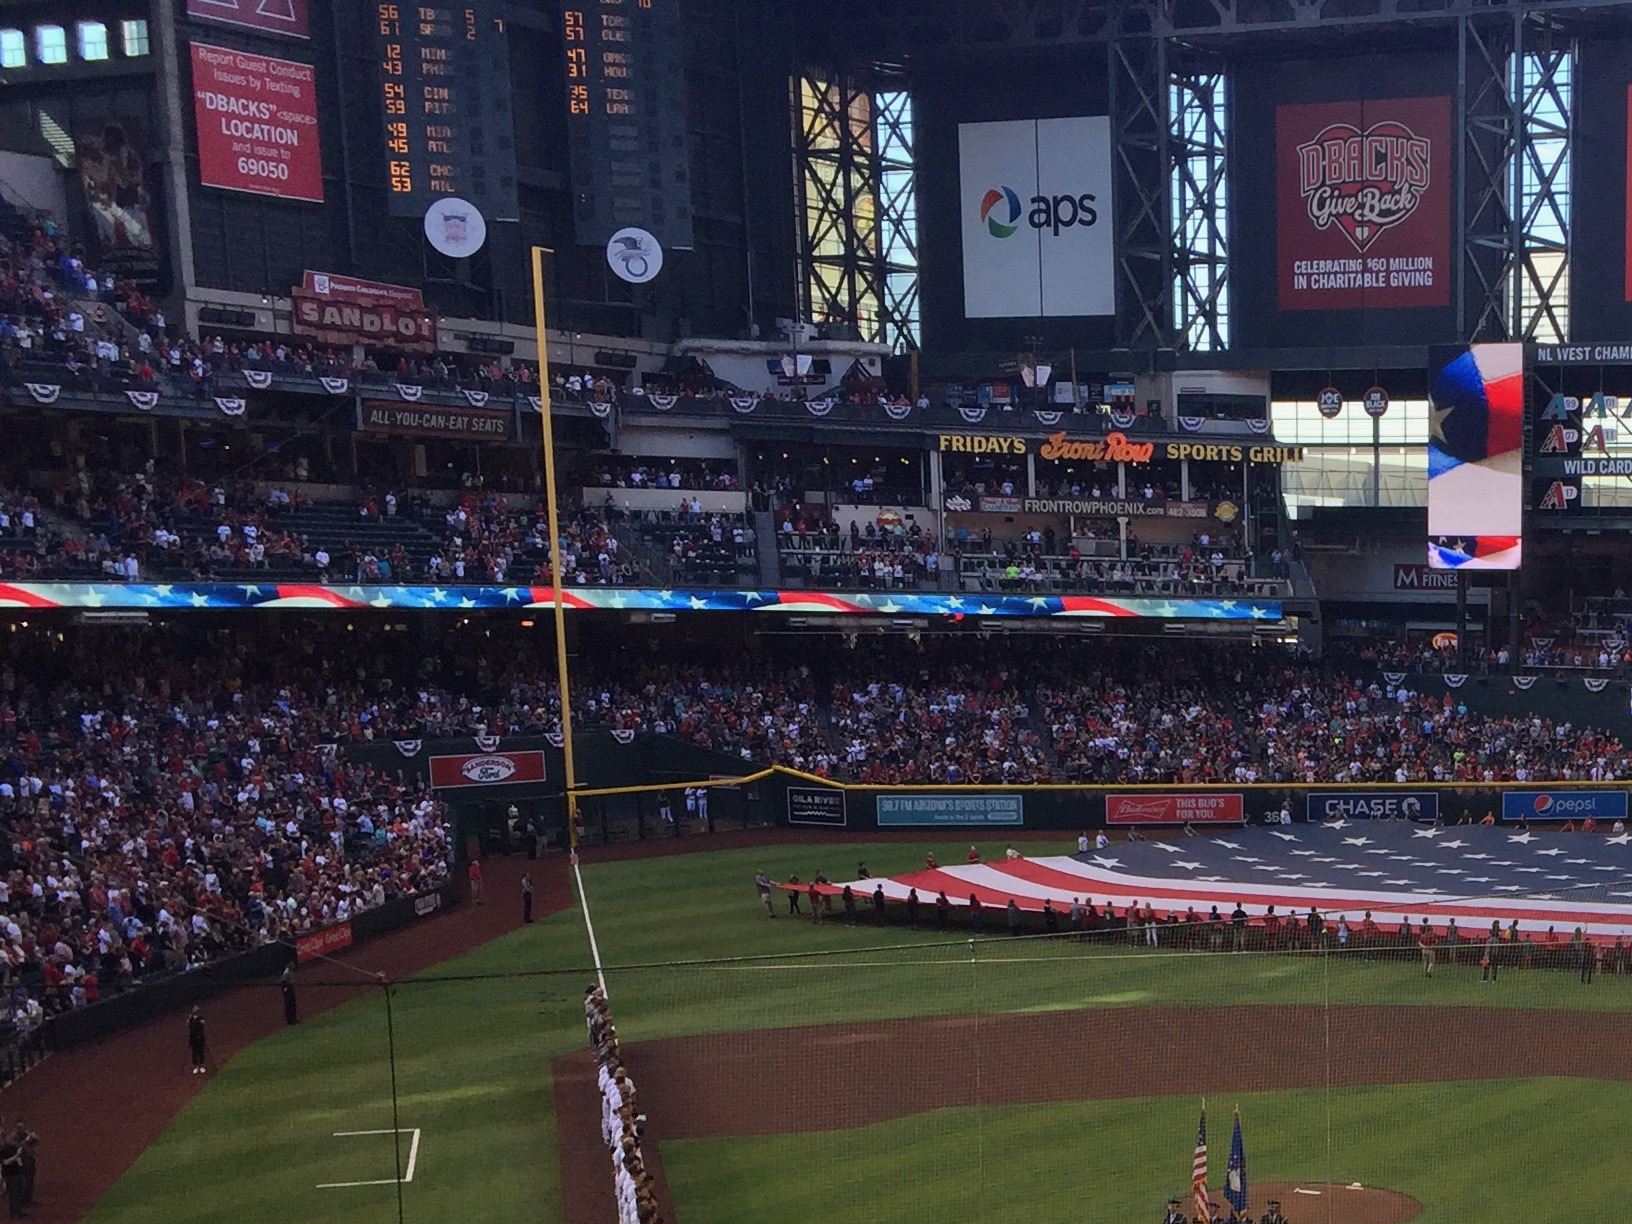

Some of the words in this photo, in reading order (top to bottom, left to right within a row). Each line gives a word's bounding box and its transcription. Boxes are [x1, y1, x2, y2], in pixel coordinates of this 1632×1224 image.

[379, 4, 399, 19] 56
[419, 7, 435, 20] TB
[565, 11, 583, 26] 57
[565, 27, 584, 40] 57
[566, 49, 586, 62] 47
[199, 48, 235, 66] Report
[236, 56, 267, 74] Guest
[269, 62, 312, 82] Conduct
[383, 61, 402, 75] 43
[569, 63, 587, 77] 31
[213, 68, 247, 86] Issues
[249, 75, 262, 91] by
[264, 77, 301, 98] Texting
[384, 83, 404, 98] 54
[386, 99, 405, 114] 59
[221, 117, 299, 146] LOCATION
[387, 123, 407, 137] 49
[231, 141, 251, 153] and
[254, 144, 279, 158] issue
[280, 146, 291, 160] to
[389, 139, 409, 153] 45
[428, 140, 452, 153] ATL
[237, 156, 289, 180] 69050
[390, 161, 410, 176] 62
[392, 177, 411, 192] 53
[431, 179, 456, 192] MIL
[1311, 185, 1357, 225] Give
[1358, 183, 1416, 222] Back
[1028, 192, 1098, 237] aps
[1293, 258, 1364, 274] CELEBRATING
[1366, 257, 1387, 270] $60
[1389, 256, 1433, 271] MILLION
[1294, 275, 1307, 290] IN
[1310, 272, 1387, 289] CHARITABLE
[1389, 271, 1433, 288] GIVING
[302, 302, 433, 336] SANDLOT
[1538, 348, 1553, 361] NL
[1556, 346, 1593, 361] WEST
[370, 409, 470, 430] ALL-YOU-CAN-EAT
[471, 418, 504, 433] SEATS
[939, 435, 1027, 455] FRIDAY'S
[1040, 431, 1104, 461] Front
[1104, 431, 1154, 463] Row
[1166, 443, 1243, 461] SPORTS
[1249, 445, 1304, 463] GRILL
[1564, 460, 1596, 475] WILD
[1396, 568, 1419, 587] M
[478, 766, 501, 780] Ford
[1175, 798, 1197, 809] THIS
[1325, 799, 1398, 816] CHASE
[1555, 796, 1598, 813] pepsi
[1176, 809, 1194, 820] FOR
